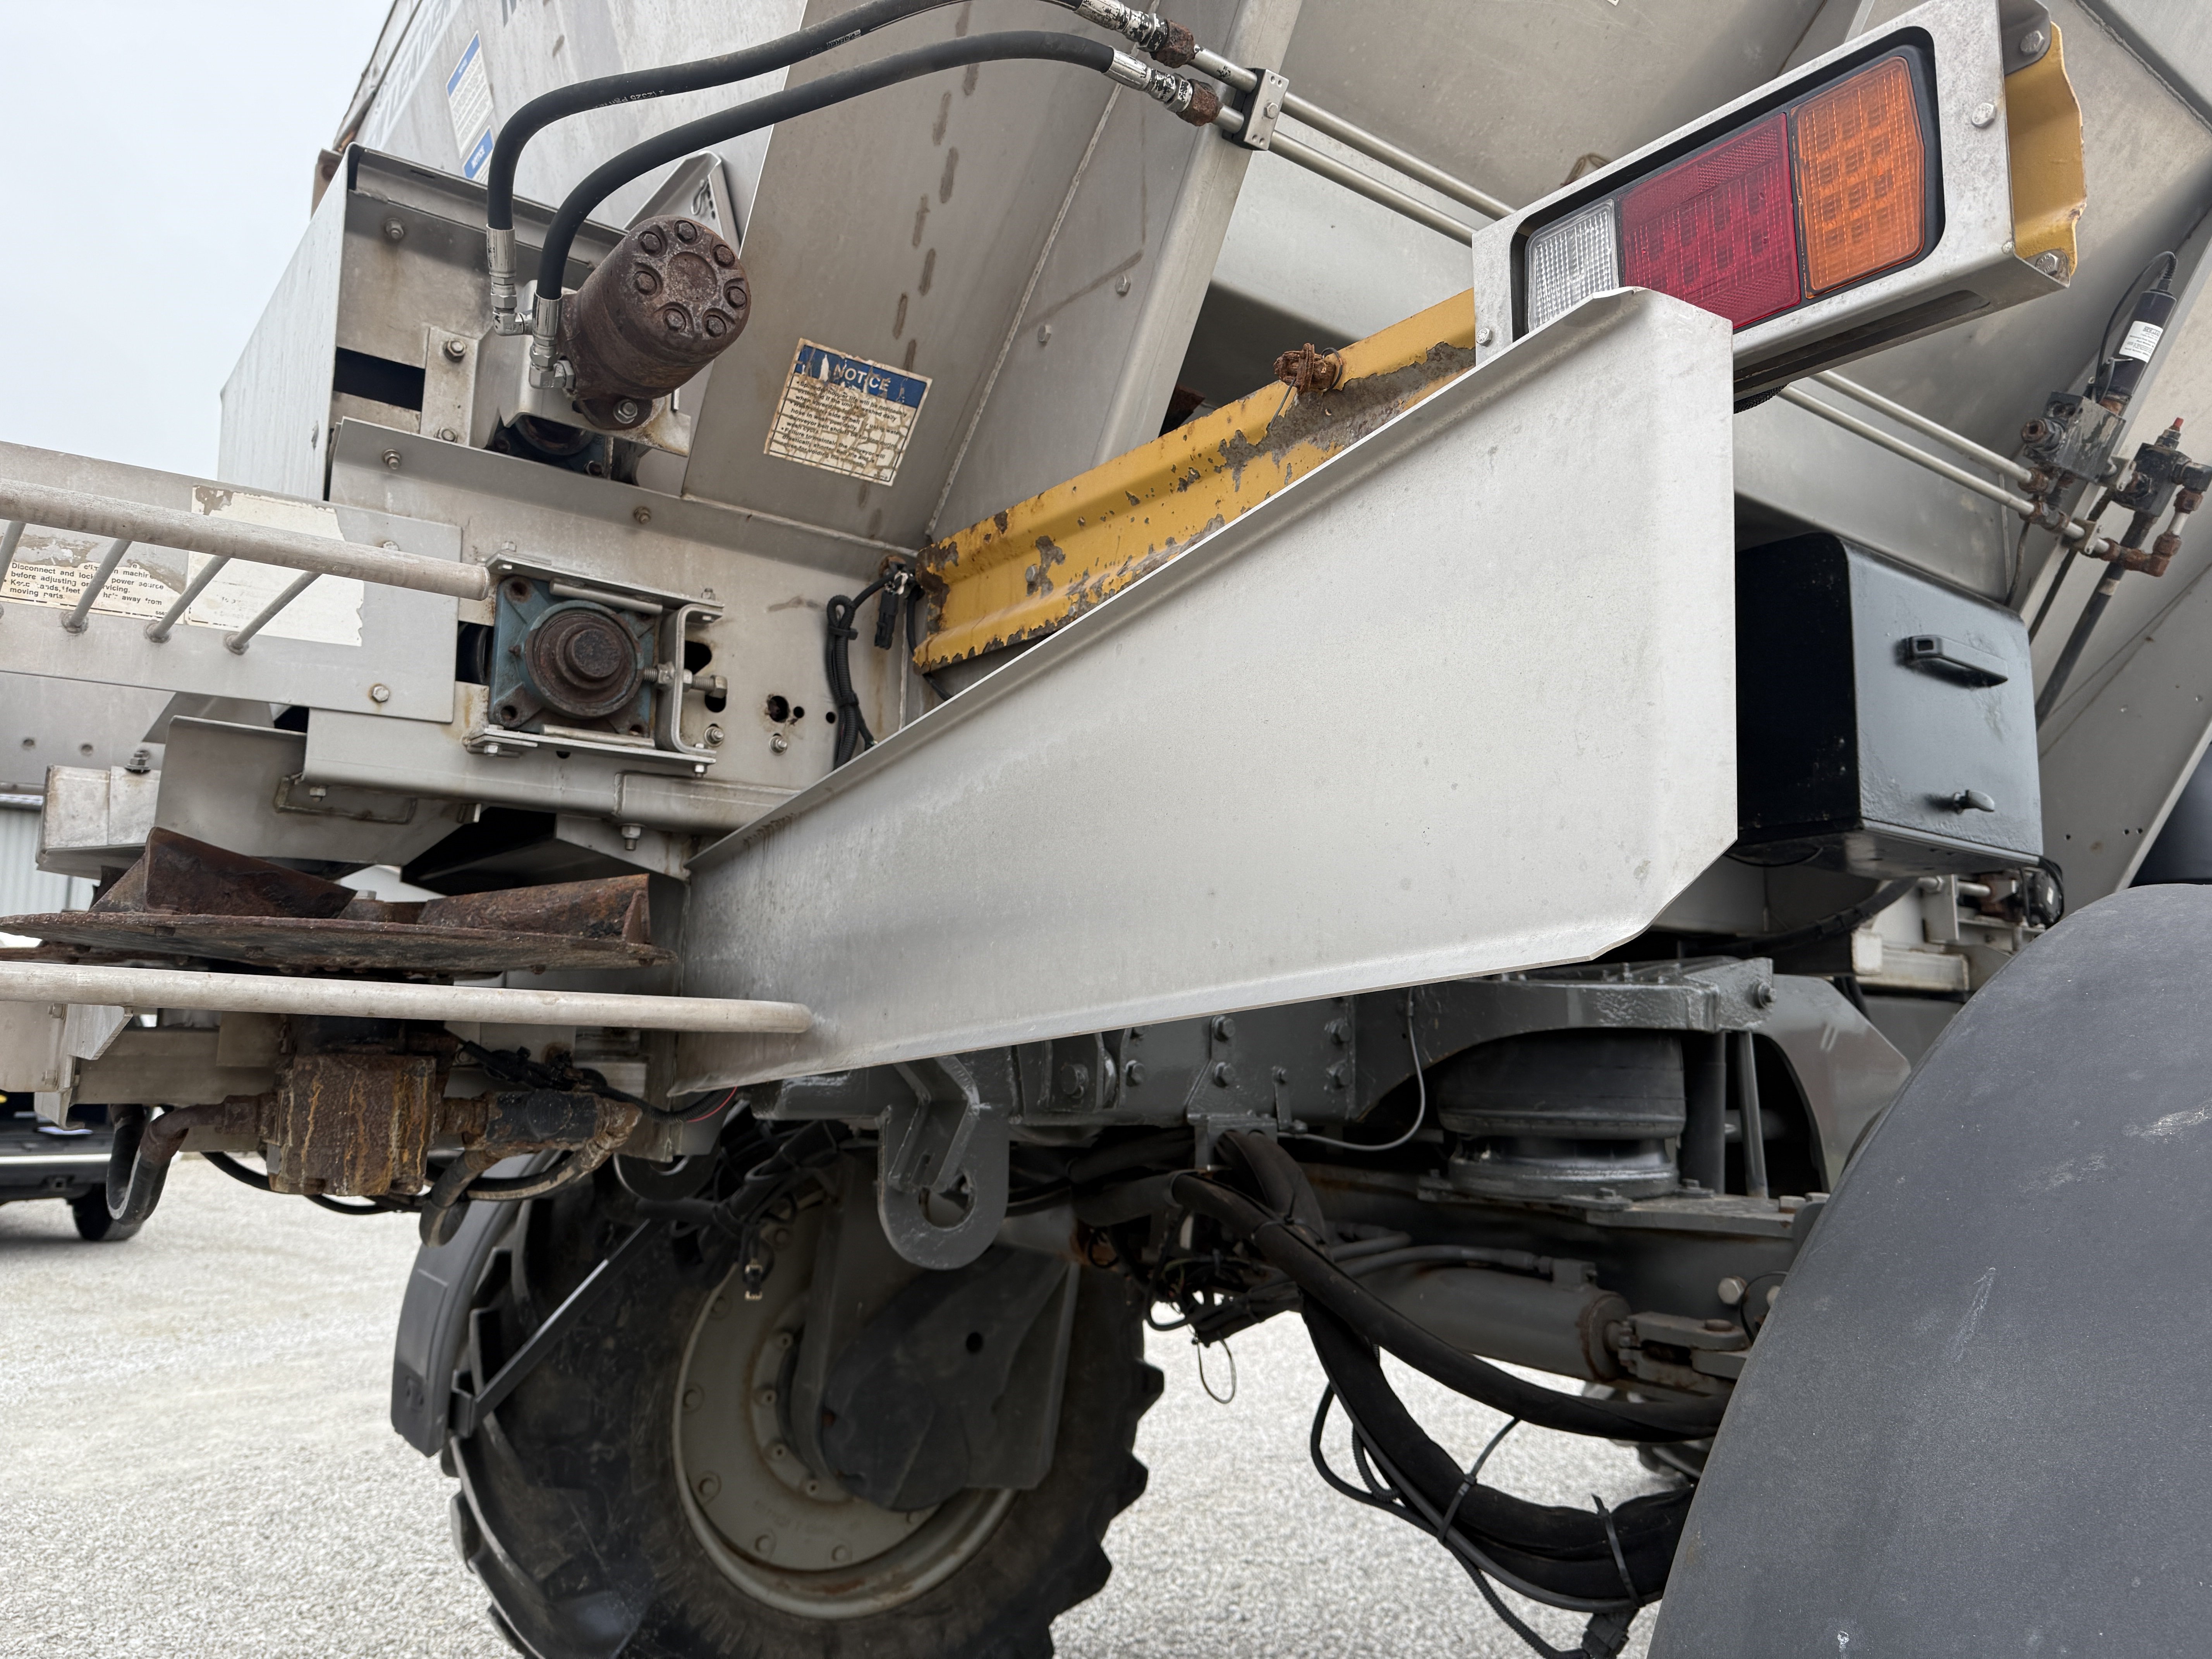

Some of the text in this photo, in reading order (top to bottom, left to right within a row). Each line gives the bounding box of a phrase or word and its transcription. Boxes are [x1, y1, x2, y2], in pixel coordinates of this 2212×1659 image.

[833, 362, 891, 392] NOTCE
[795, 395, 811, 403] when
[788, 415, 817, 428] Cnveyor
[882, 413, 897, 422] daily
[784, 428, 805, 437] Failure
[848, 446, 874, 457] coveyor
[12, 563, 57, 574] Disconnect
[60, 568, 75, 577] and
[11, 570, 36, 580] before
[41, 576, 77, 587] adjusting
[103, 585, 131, 594] rvicing.
[37, 582, 61, 592] ands,
[10, 587, 39, 597] moving
